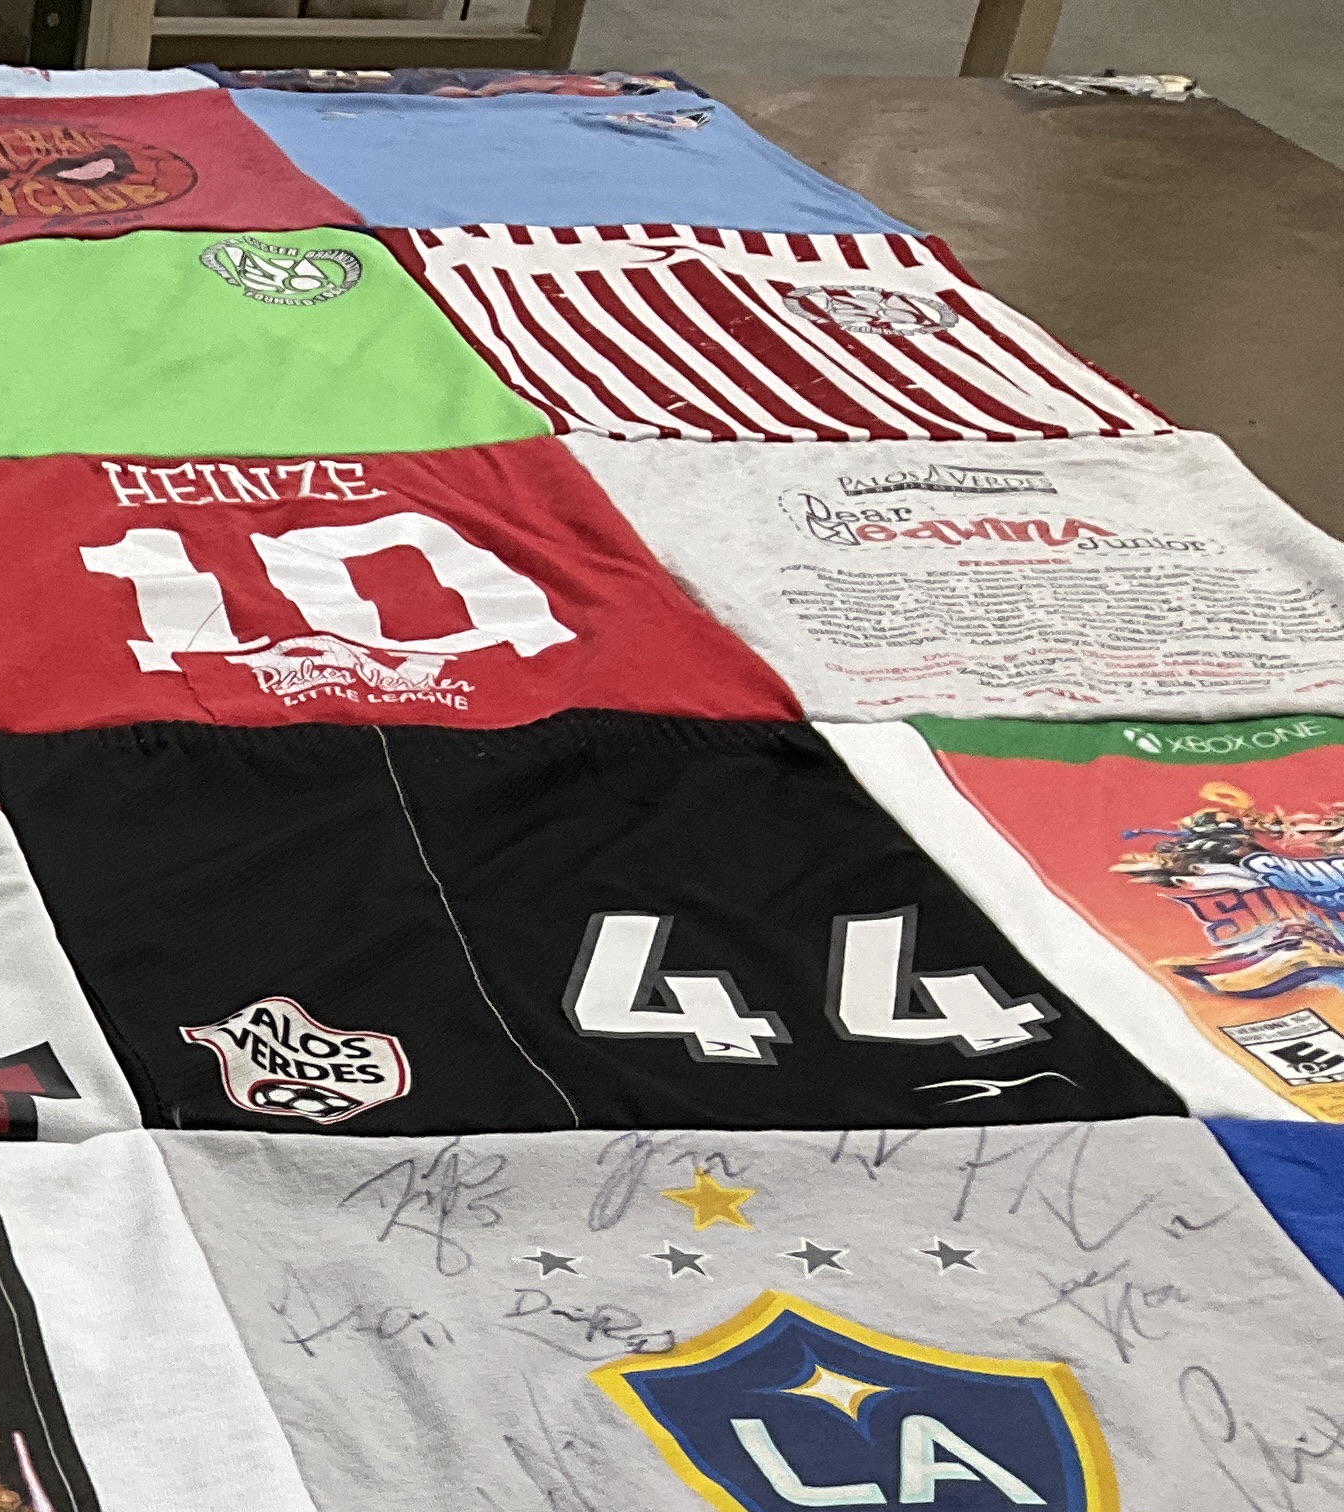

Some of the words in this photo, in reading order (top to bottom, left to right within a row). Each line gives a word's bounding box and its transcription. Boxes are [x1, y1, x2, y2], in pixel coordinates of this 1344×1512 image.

[22, 181, 170, 216] CLUB
[100, 459, 388, 508] HEINZE
[79, 511, 578, 673] 10
[284, 685, 360, 708] LITTLE
[367, 688, 470, 711] LEAGUE
[1164, 734, 1255, 754] XBOX
[1252, 720, 1327, 749] ONE
[562, 903, 1061, 1065] 44
[215, 1027, 386, 1084] VERDES
[216, 1008, 371, 1060] ALOS
[729, 1413, 1048, 1507] LA
